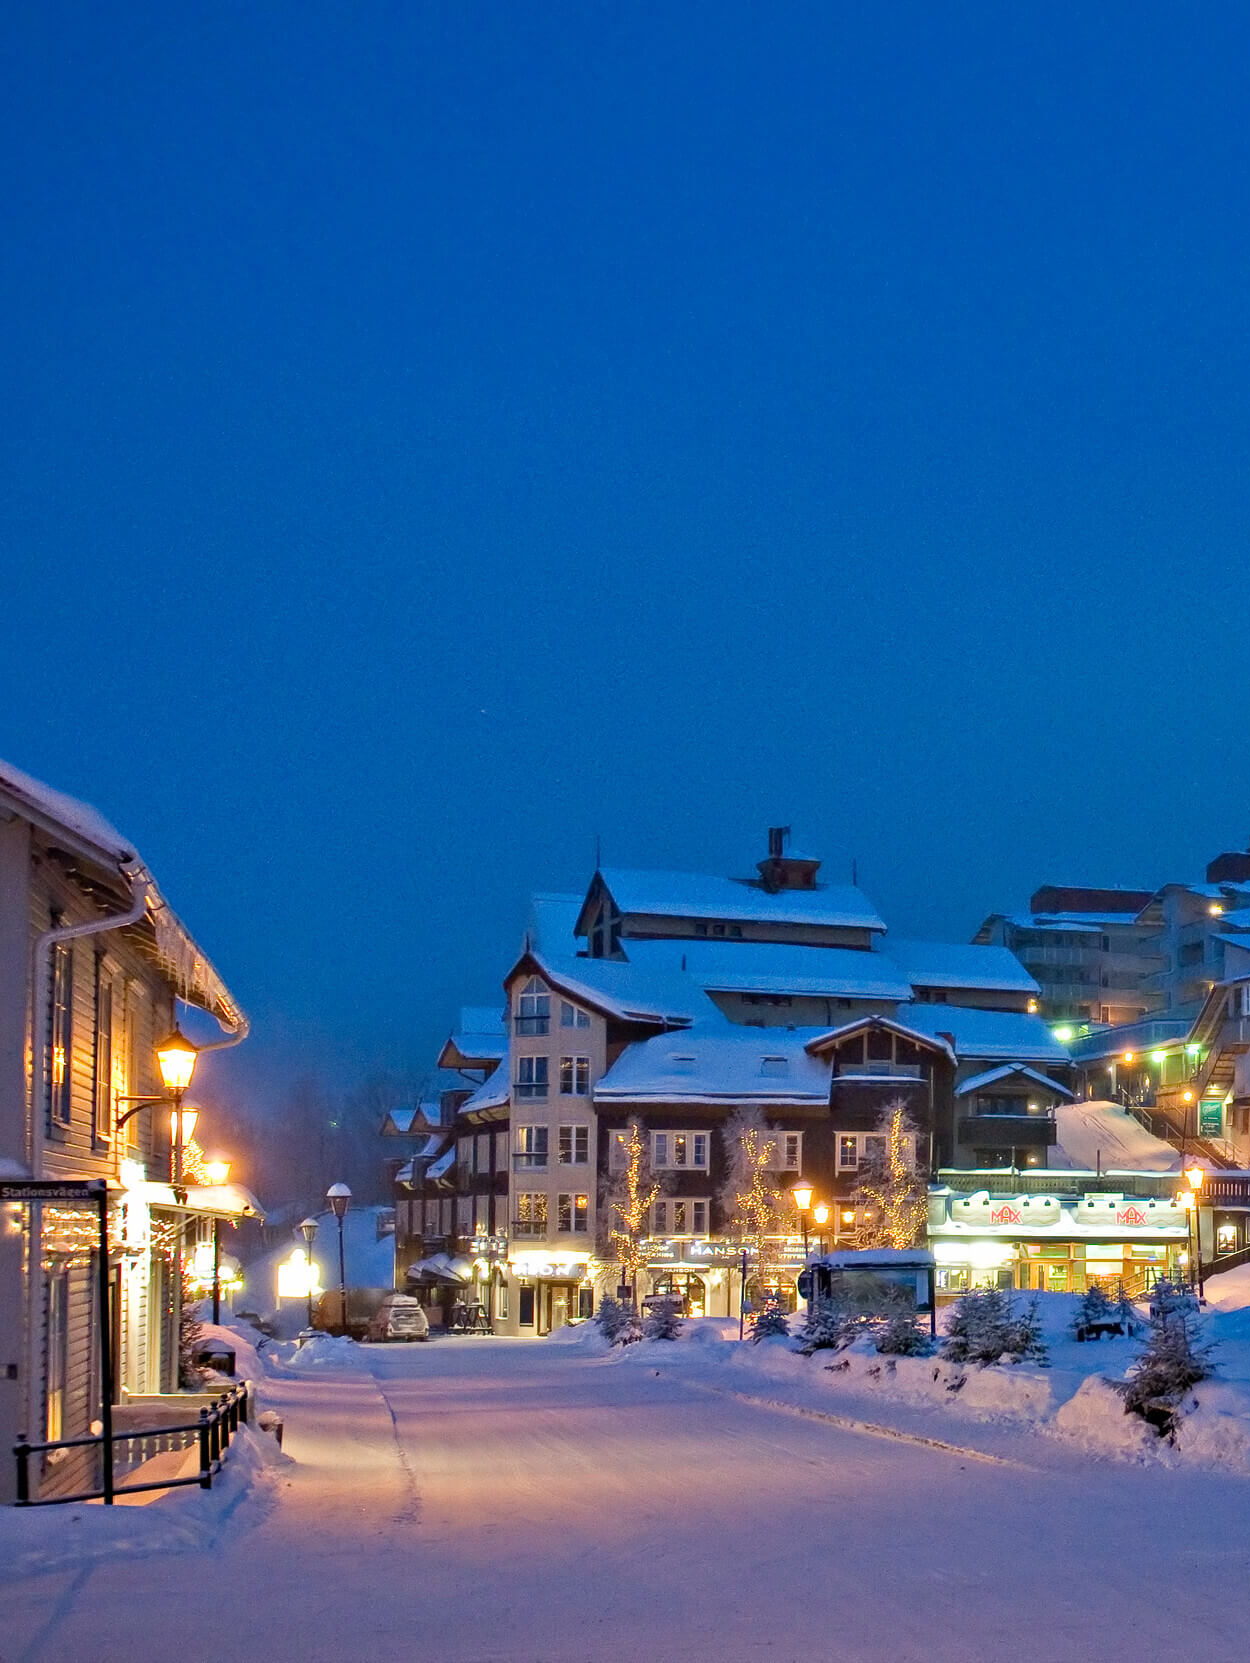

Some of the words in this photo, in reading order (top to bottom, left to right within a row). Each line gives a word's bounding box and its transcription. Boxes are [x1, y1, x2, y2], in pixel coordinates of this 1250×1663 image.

[1, 1186, 89, 1198] Stationsvägen
[991, 1205, 1023, 1224] MAX
[1116, 1206, 1147, 1225] MAX
[690, 1245, 760, 1257] HANSON
